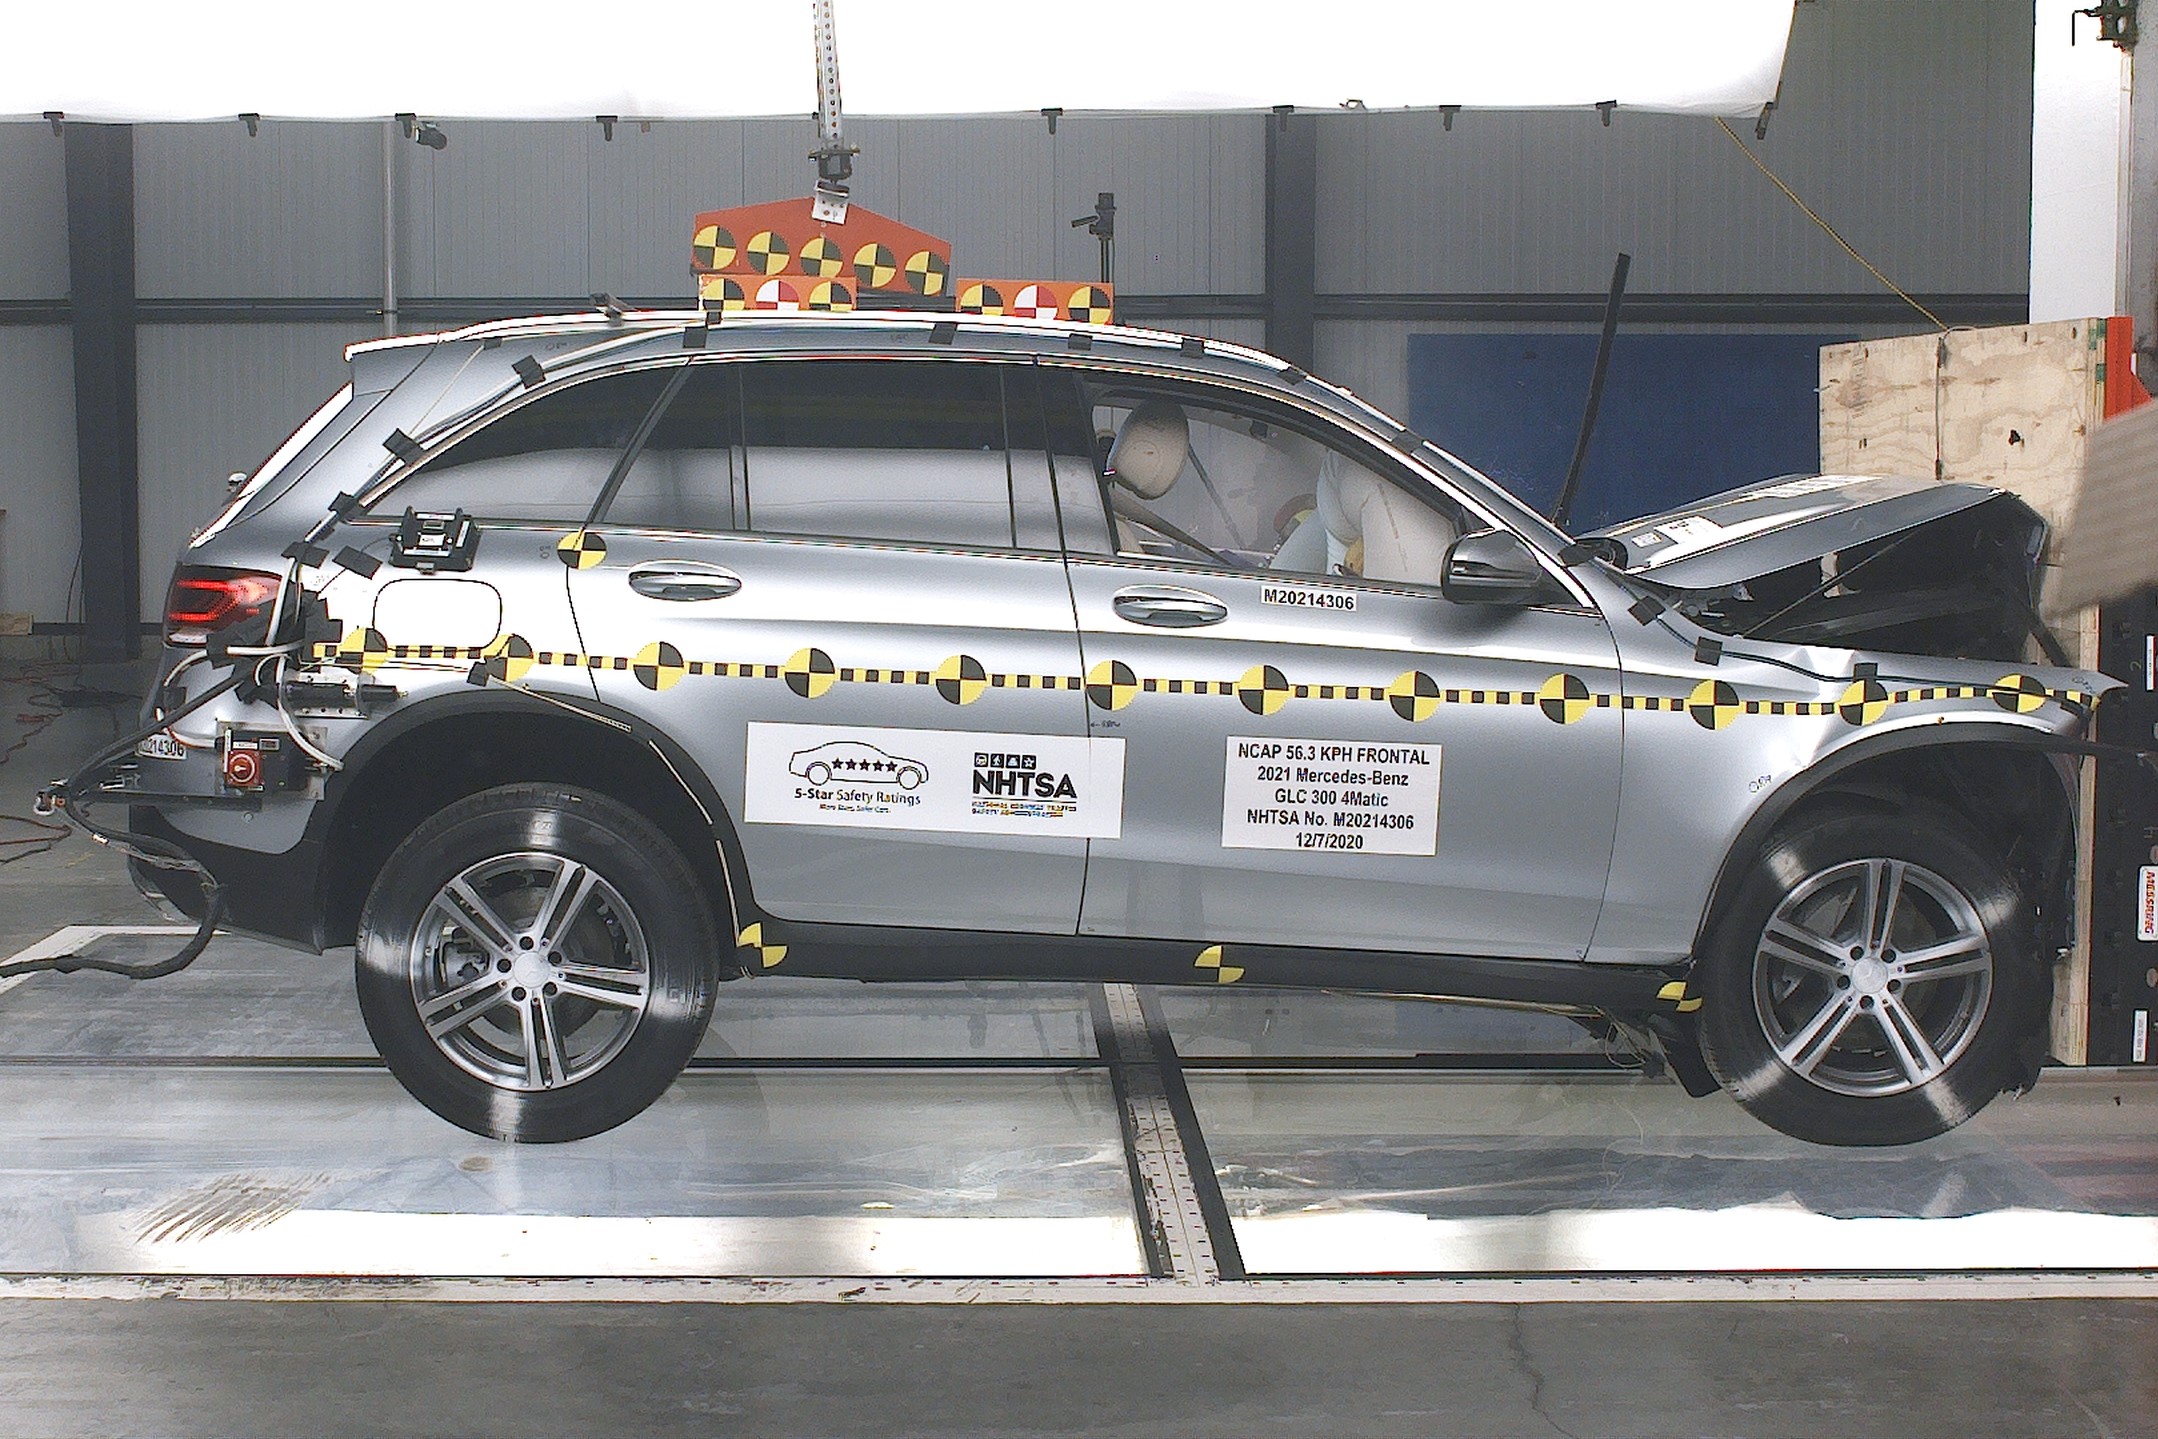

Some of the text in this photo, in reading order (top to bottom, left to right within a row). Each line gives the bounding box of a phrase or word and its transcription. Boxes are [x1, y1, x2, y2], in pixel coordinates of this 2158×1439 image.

[1264, 588, 1354, 610] M20214306
[1238, 742, 1430, 765] NCAP 56.3 KPH FRONTAL
[972, 769, 1078, 799] NHTSA
[1257, 765, 1409, 786] 2021 Mercedes-Benz
[794, 787, 921, 807] 5-Star Safety Ratings
[1275, 787, 1389, 807] GLC 300 4Matic
[1247, 808, 1414, 830] NHTSA No. M20214306
[1295, 832, 1364, 850] 12/7/2020
